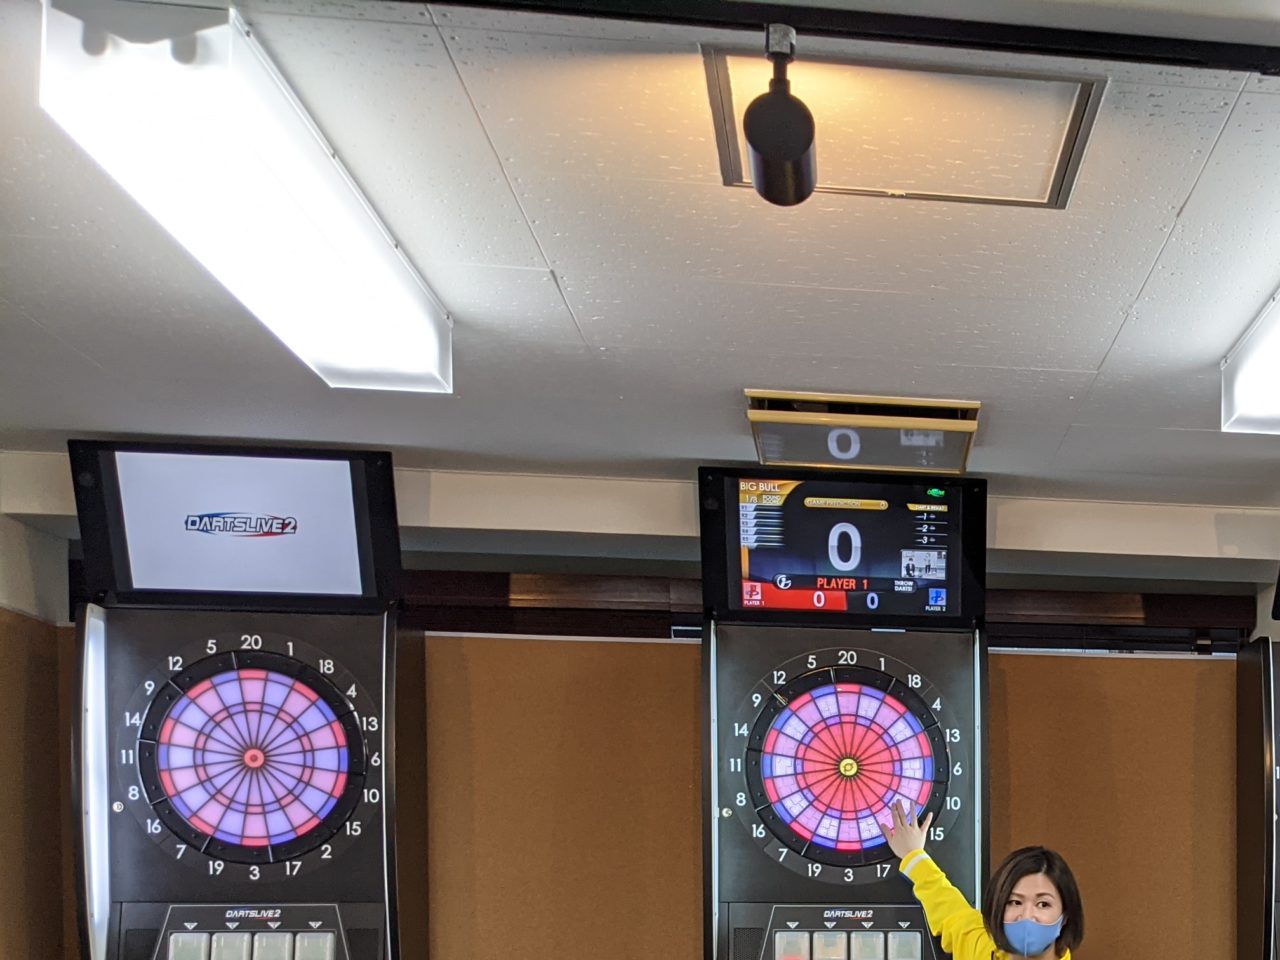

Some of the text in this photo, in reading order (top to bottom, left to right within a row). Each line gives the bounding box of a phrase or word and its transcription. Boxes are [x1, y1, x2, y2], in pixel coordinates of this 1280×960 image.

[740, 482, 780, 491] BIG BULL
[186, 515, 297, 534] DARTSLIVE2
[828, 522, 862, 572] 0
[817, 577, 868, 590] PLAYER 1
[813, 591, 825, 607] 0
[866, 592, 879, 609] 0
[207, 640, 216, 653] 5
[241, 635, 262, 649] 20
[288, 642, 293, 656] 1
[169, 657, 182, 670] 12
[807, 655, 816, 668] 5
[838, 651, 857, 664] 20
[320, 660, 334, 673] 18
[880, 658, 884, 671] 1
[774, 671, 785, 684] 12
[908, 675, 921, 688] 18
[145, 681, 154, 695] 9
[347, 684, 357, 697] 4
[752, 694, 761, 707] 9
[932, 698, 941, 711] 4
[125, 712, 142, 728] 14
[363, 717, 378, 731] 13
[735, 723, 748, 736] 14
[946, 729, 960, 742] 13
[121, 750, 133, 764] 11
[371, 752, 380, 766] 6
[730, 759, 740, 771] 11
[953, 762, 962, 775] 6
[128, 786, 139, 800] 8
[364, 789, 379, 803] 10
[736, 793, 746, 806] 8
[946, 797, 960, 810] 10
[147, 819, 161, 833] 16
[346, 822, 361, 835] 15
[752, 824, 765, 837] 16
[928, 826, 944, 840] 15
[177, 845, 186, 859] 7
[322, 845, 331, 858] 2
[779, 849, 788, 861] 7
[209, 861, 224, 874] 19
[250, 866, 259, 880] 3
[286, 862, 301, 875] 17
[808, 864, 821, 876] 19
[877, 865, 890, 877] 17
[844, 869, 853, 881] 3
[225, 909, 281, 918] DARTSLIVE2
[823, 910, 873, 918] DARTSLIVE2
